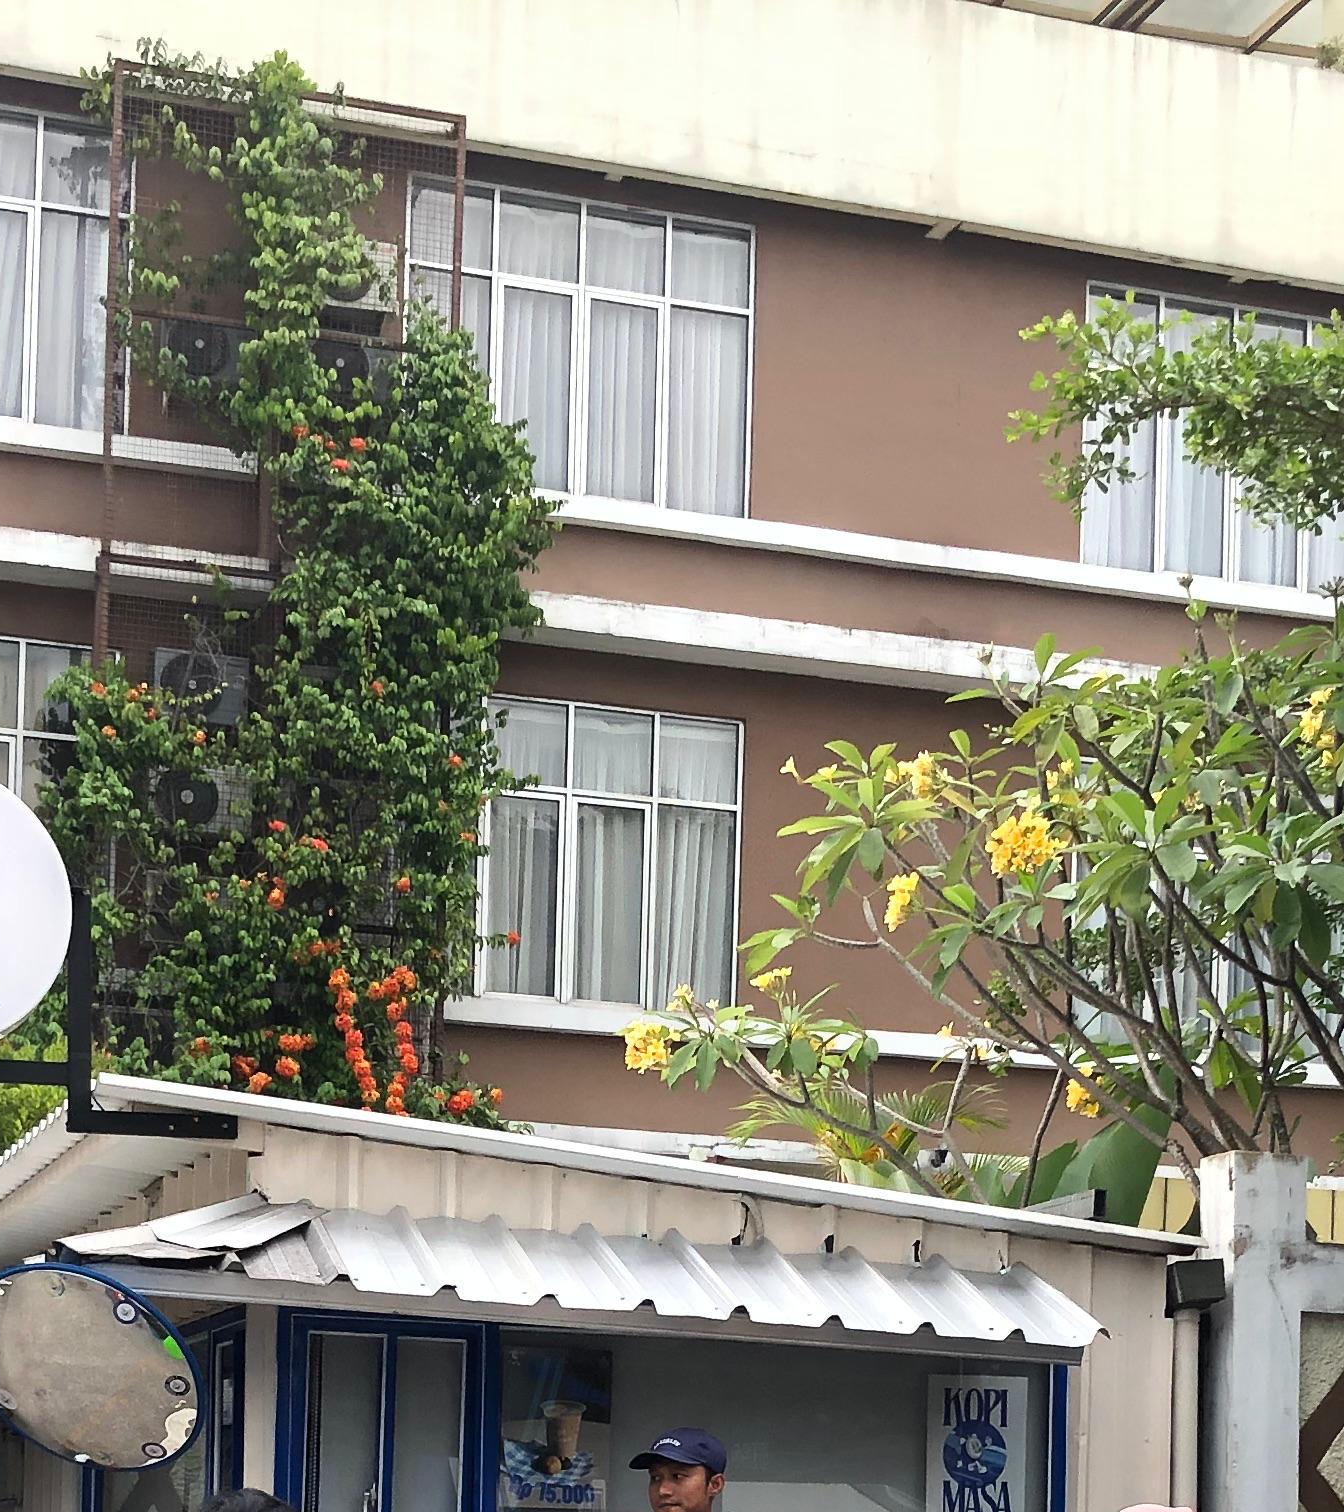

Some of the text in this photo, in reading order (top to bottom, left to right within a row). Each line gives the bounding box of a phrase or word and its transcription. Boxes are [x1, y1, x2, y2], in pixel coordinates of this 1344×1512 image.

[943, 1388, 1009, 1427] KOPI
[510, 1474, 595, 1504] Rp 15.000
